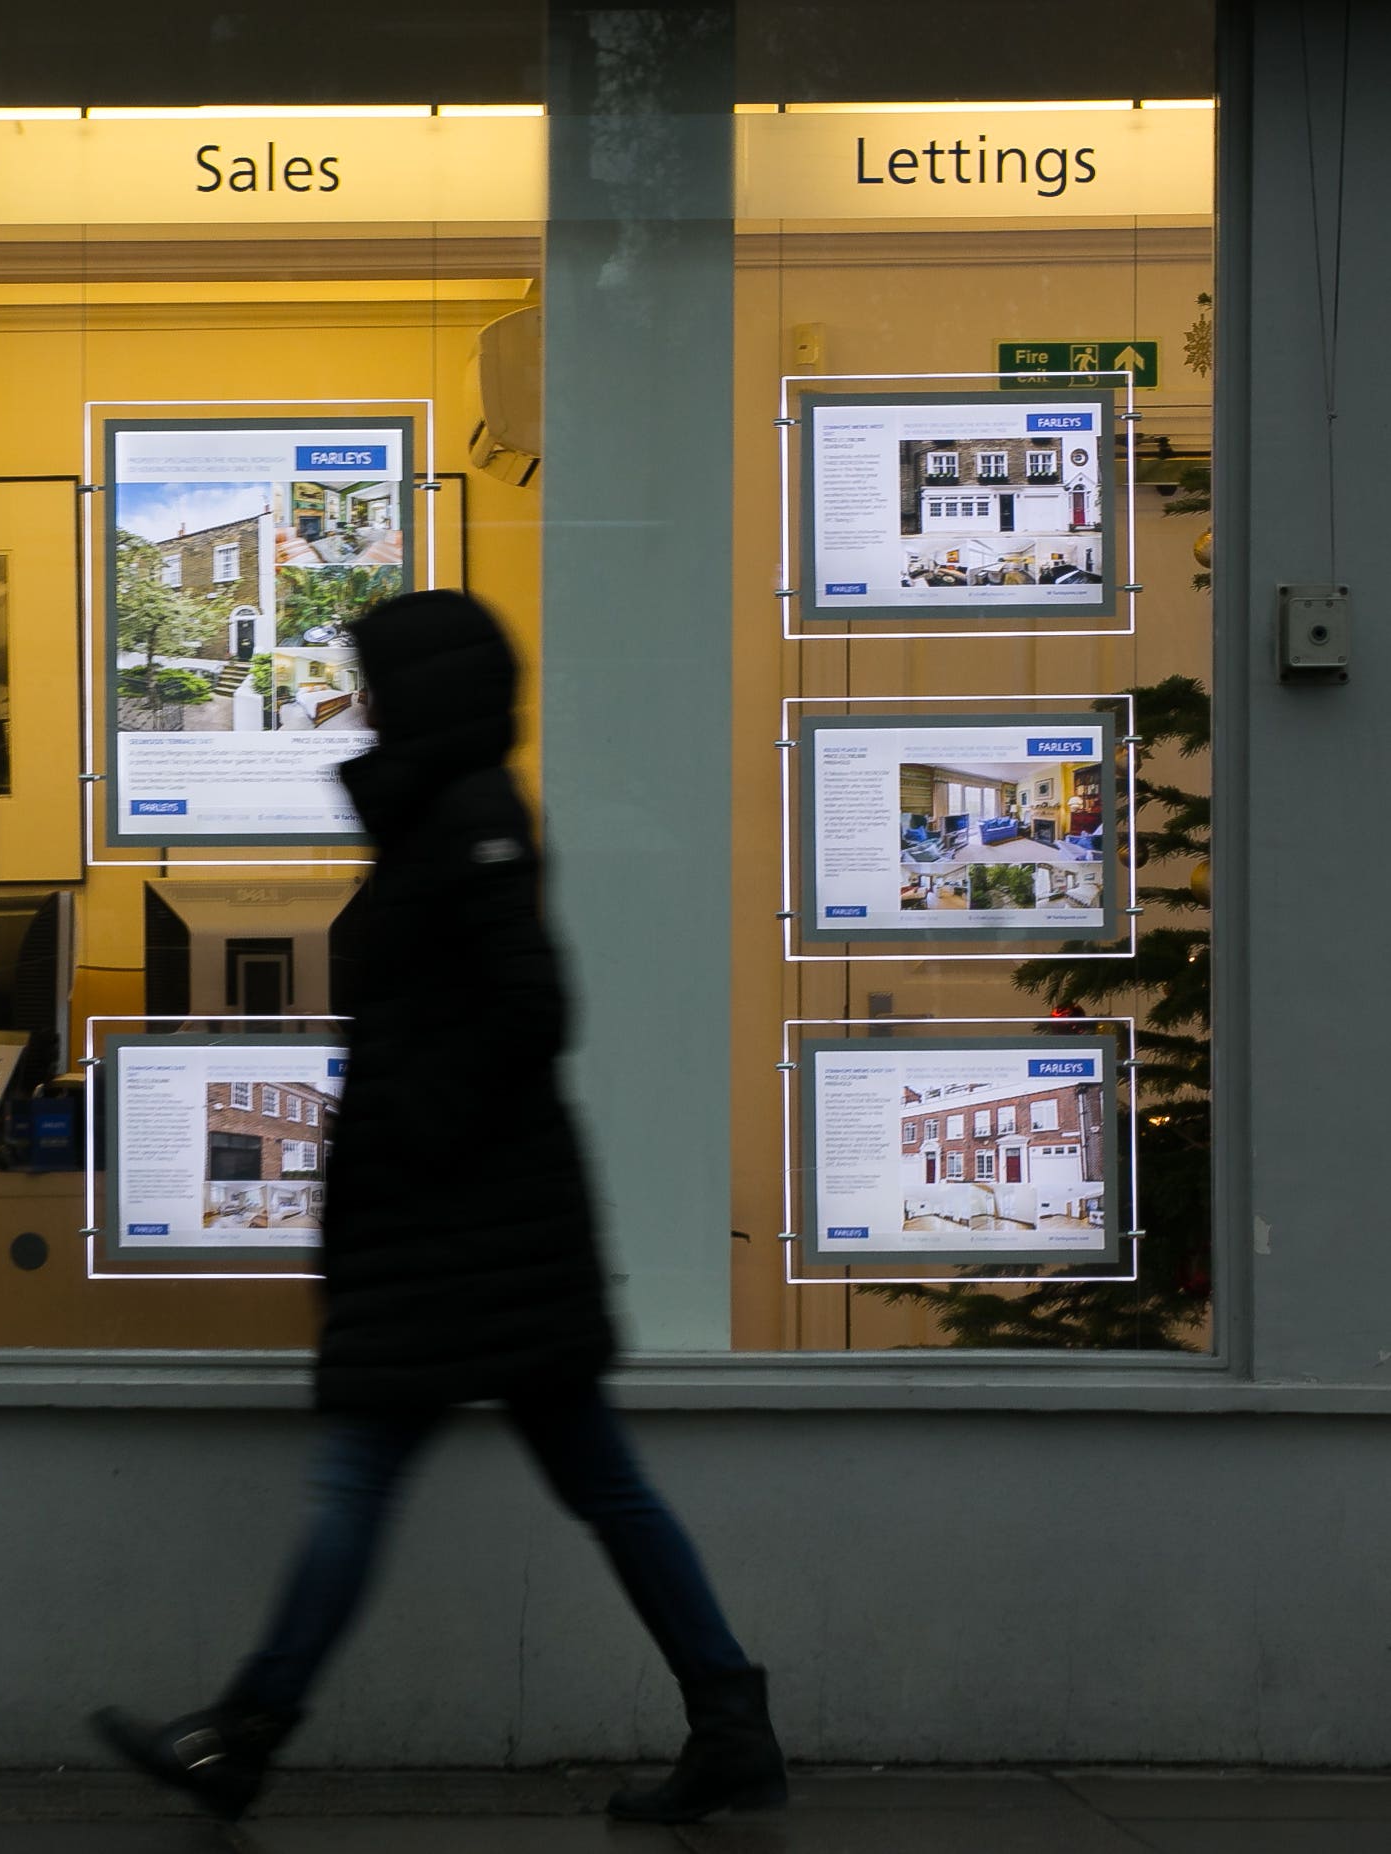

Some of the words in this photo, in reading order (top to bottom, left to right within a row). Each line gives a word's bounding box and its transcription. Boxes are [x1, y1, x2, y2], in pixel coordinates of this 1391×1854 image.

[197, 142, 340, 193] Sales
[858, 135, 1096, 198] Lettings
[1015, 349, 1049, 364] Fire
[1037, 417, 1082, 428] FARLEYS
[311, 452, 372, 465] FARLEYS
[1037, 742, 1083, 752] FARLEYS
[138, 803, 179, 812] FARLEYS
[1039, 1063, 1084, 1073] FARLEYS
